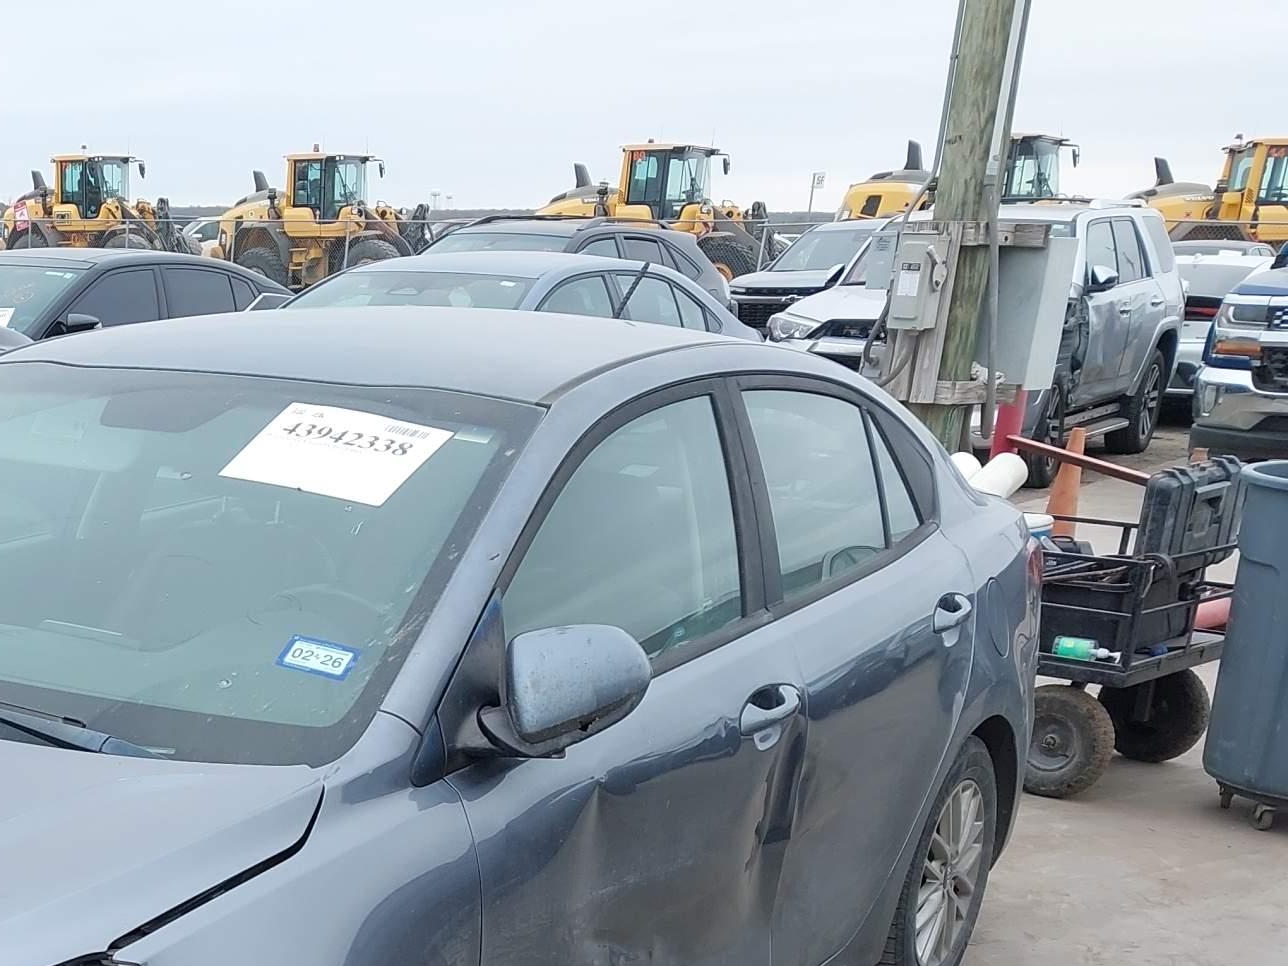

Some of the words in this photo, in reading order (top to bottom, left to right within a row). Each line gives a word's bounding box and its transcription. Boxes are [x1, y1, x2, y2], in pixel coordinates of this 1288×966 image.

[282, 421, 414, 457] 43942338
[291, 647, 314, 661] 02
[319, 654, 344, 669] 26
